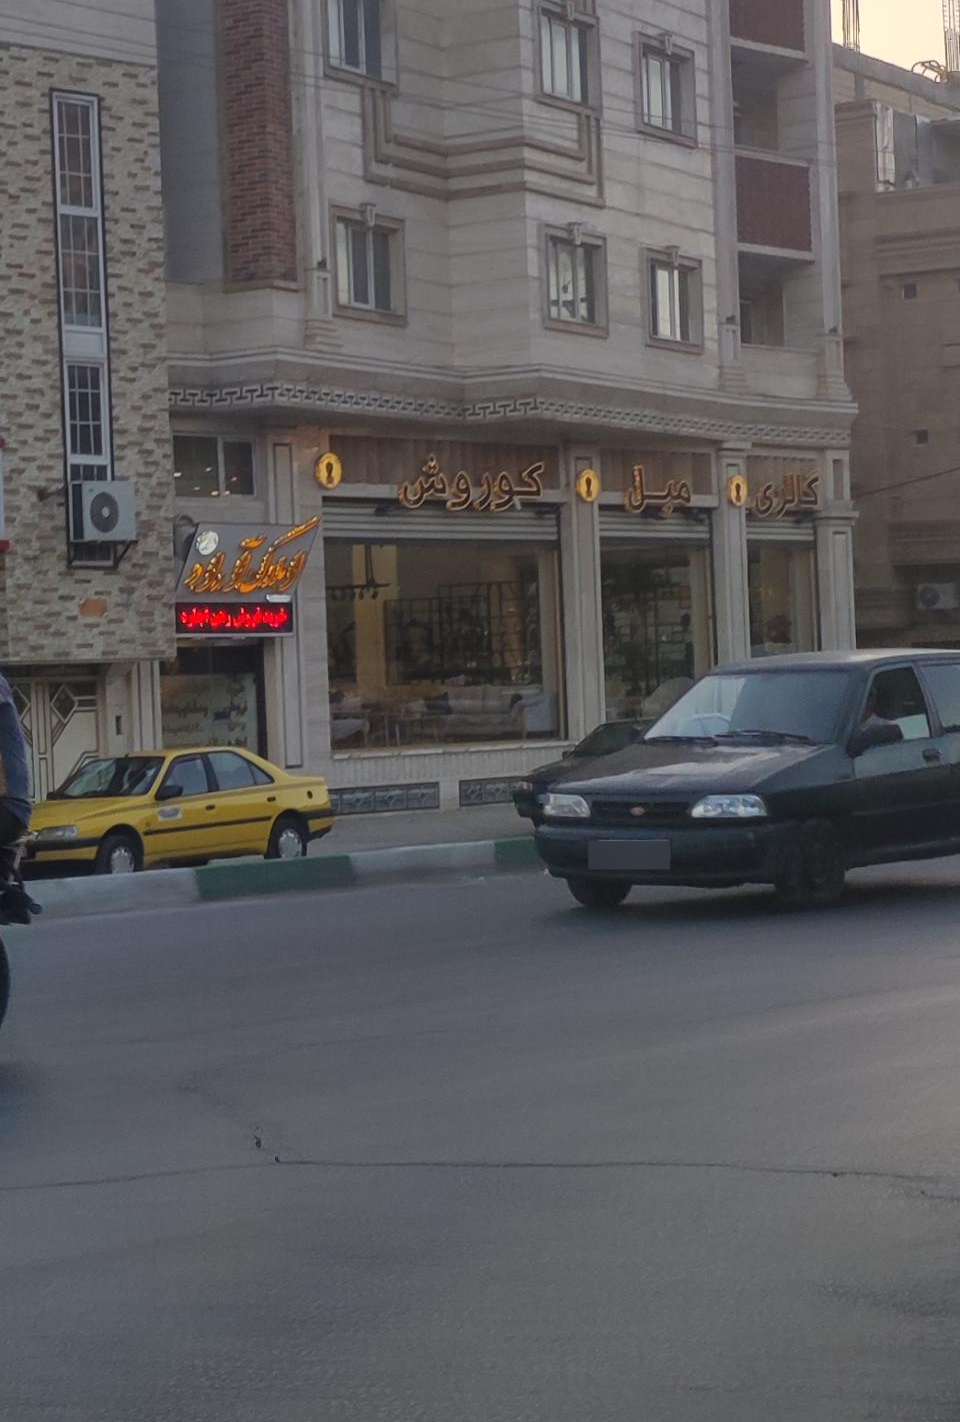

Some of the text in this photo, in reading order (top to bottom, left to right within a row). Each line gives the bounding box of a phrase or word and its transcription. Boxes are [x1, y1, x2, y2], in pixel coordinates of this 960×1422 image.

[398, 452, 821, 520] گالری مبل کوروش
